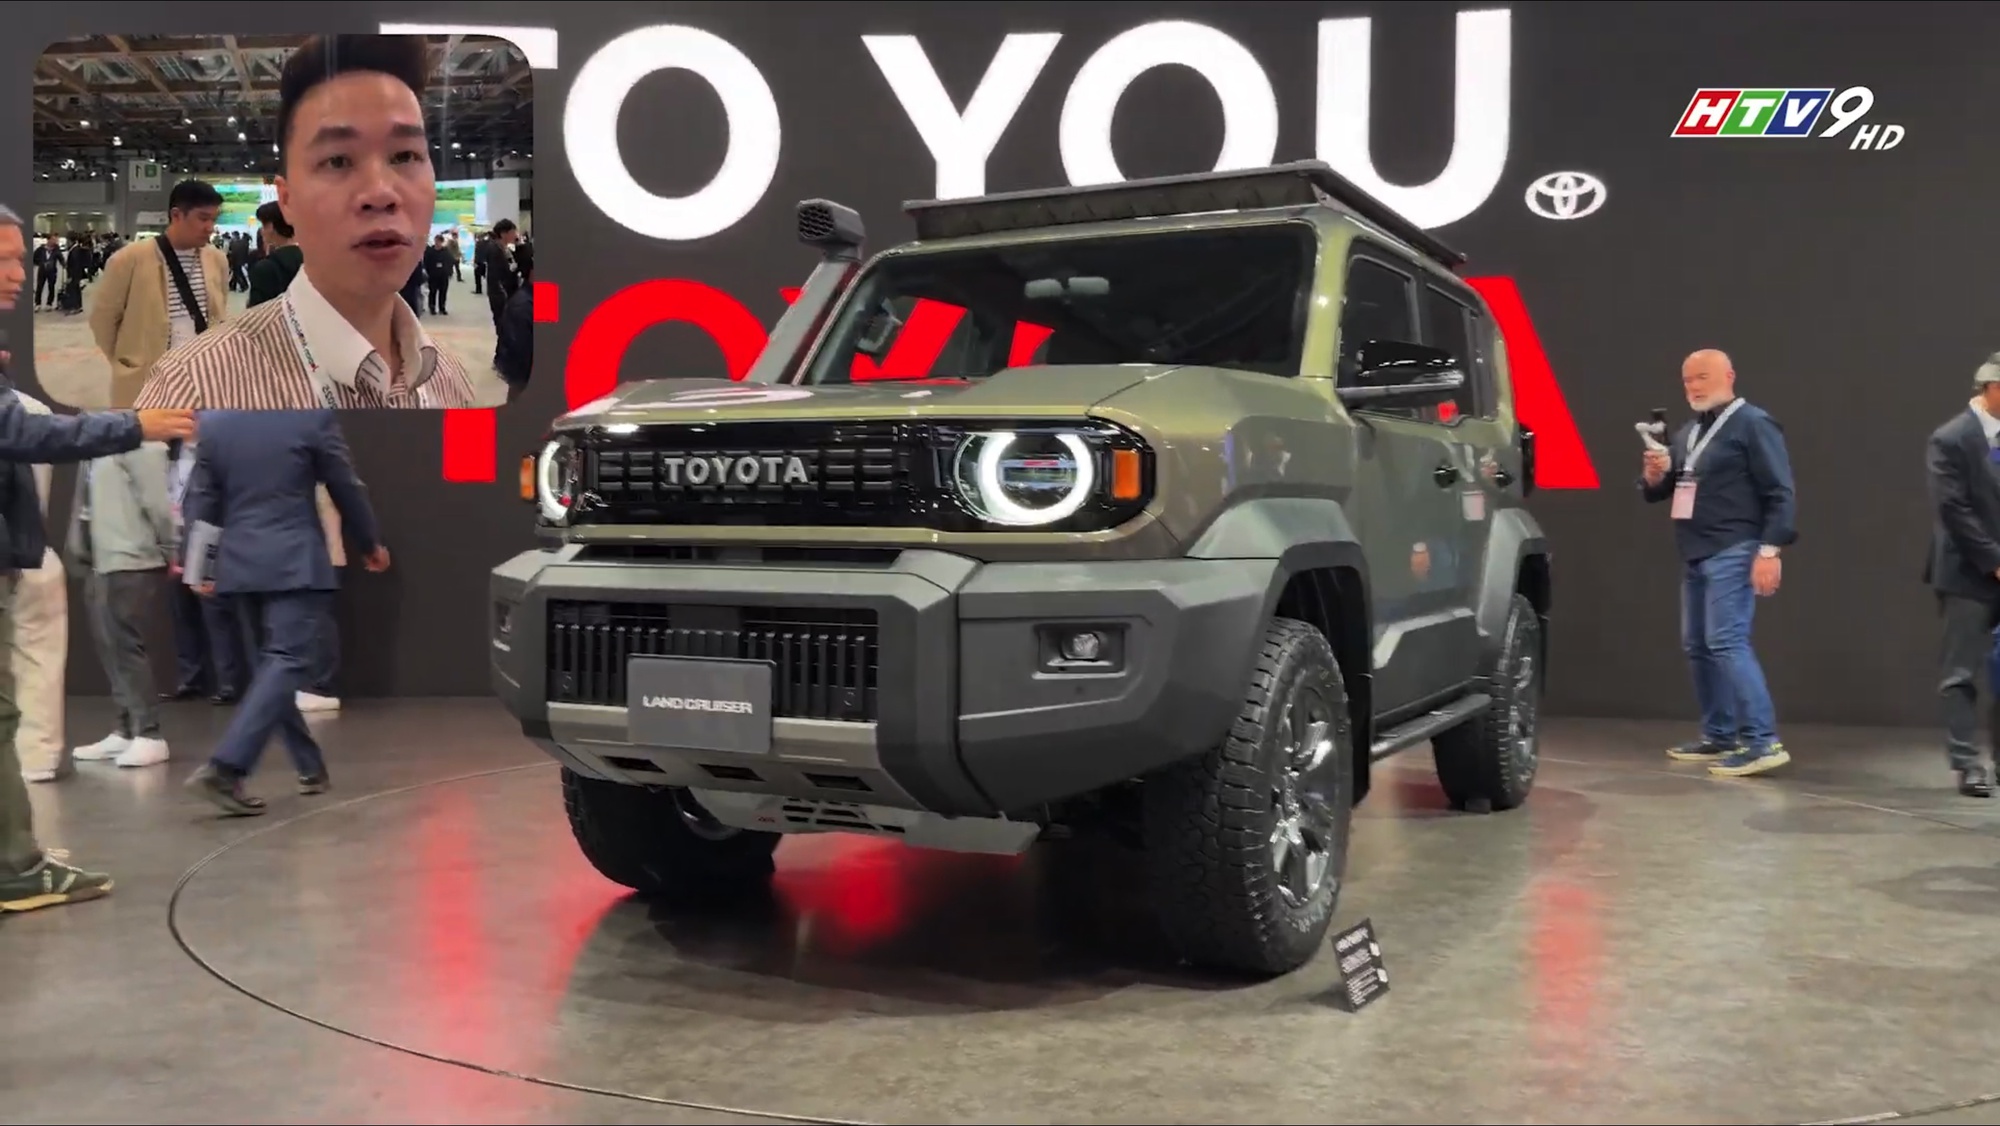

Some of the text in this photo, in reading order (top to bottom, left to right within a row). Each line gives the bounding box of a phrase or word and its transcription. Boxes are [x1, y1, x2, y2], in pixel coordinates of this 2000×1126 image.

[379, 22, 781, 241] O
[664, 456, 809, 485] TOYOTA
[642, 694, 753, 714] LAND CRUISER
